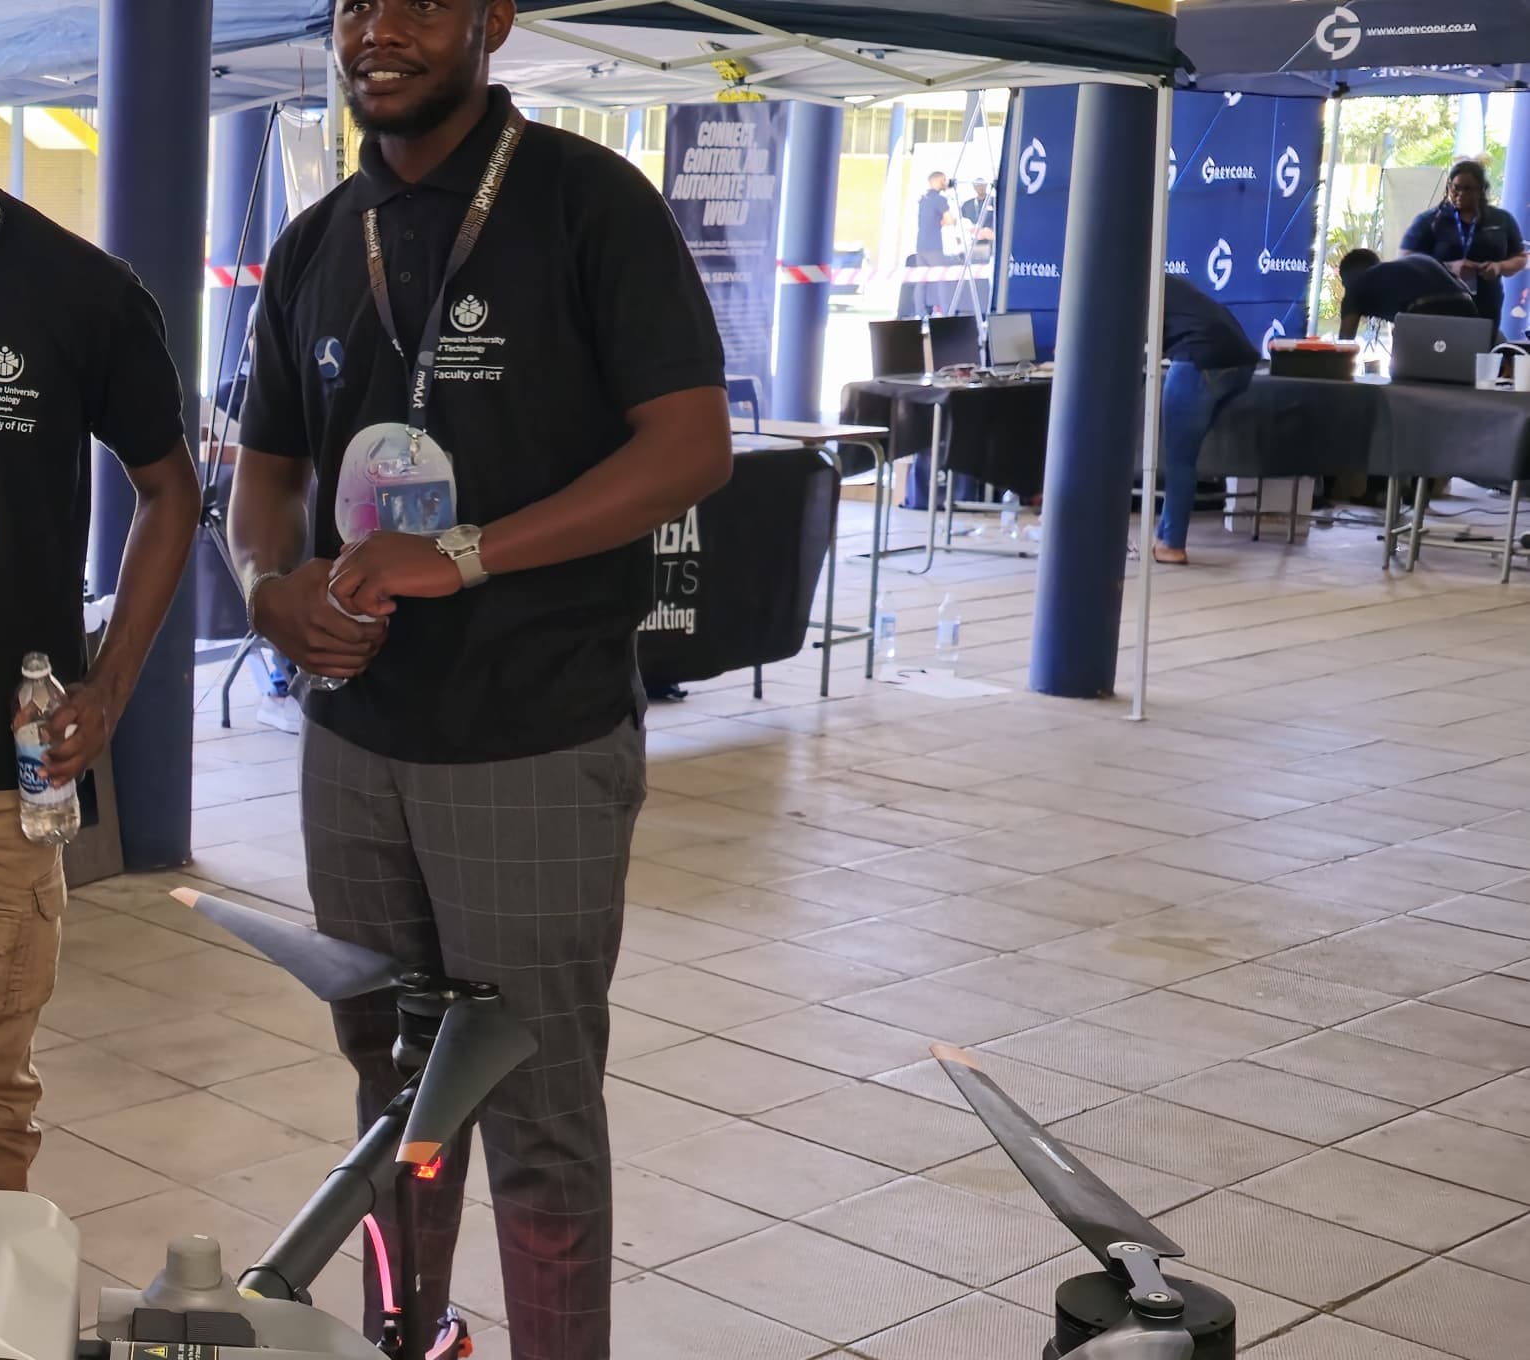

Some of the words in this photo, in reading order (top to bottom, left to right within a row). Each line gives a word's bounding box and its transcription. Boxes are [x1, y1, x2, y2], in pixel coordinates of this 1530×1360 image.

[683, 148, 742, 174] CONTROL
[671, 174, 745, 200] AUTOMATE
[702, 200, 750, 226] WORLD
[433, 369, 471, 382] Faculty
[472, 369, 484, 380] of
[485, 370, 502, 381] ICT
[4, 386, 40, 399] University
[5, 420, 17, 430] of
[17, 421, 35, 433] ICT
